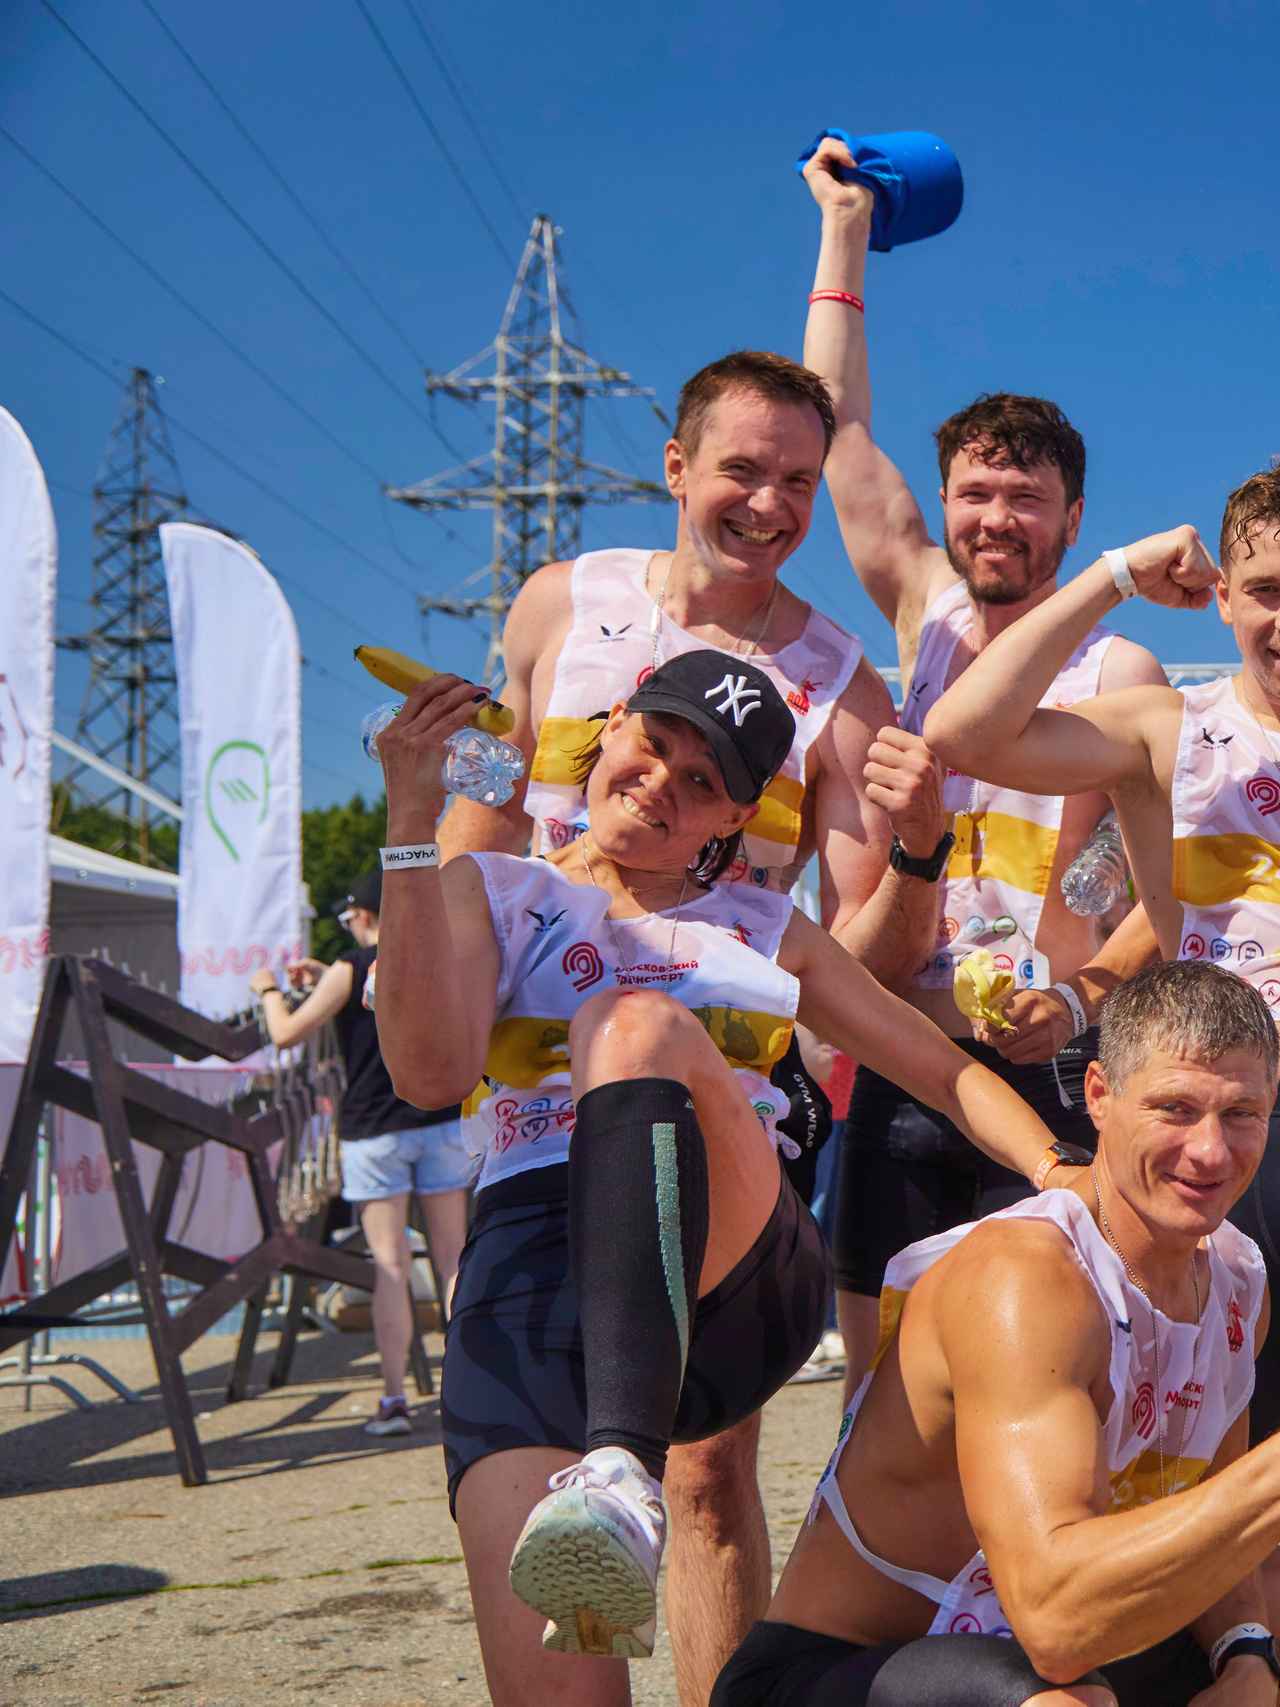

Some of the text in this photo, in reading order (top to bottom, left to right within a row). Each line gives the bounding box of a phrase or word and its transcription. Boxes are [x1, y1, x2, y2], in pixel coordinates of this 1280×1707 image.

[705, 673, 762, 728] NY
[615, 972, 685, 986] транспорт
[1075, 1009, 1084, 1034] УЧАС
[793, 1073, 813, 1103] GYM
